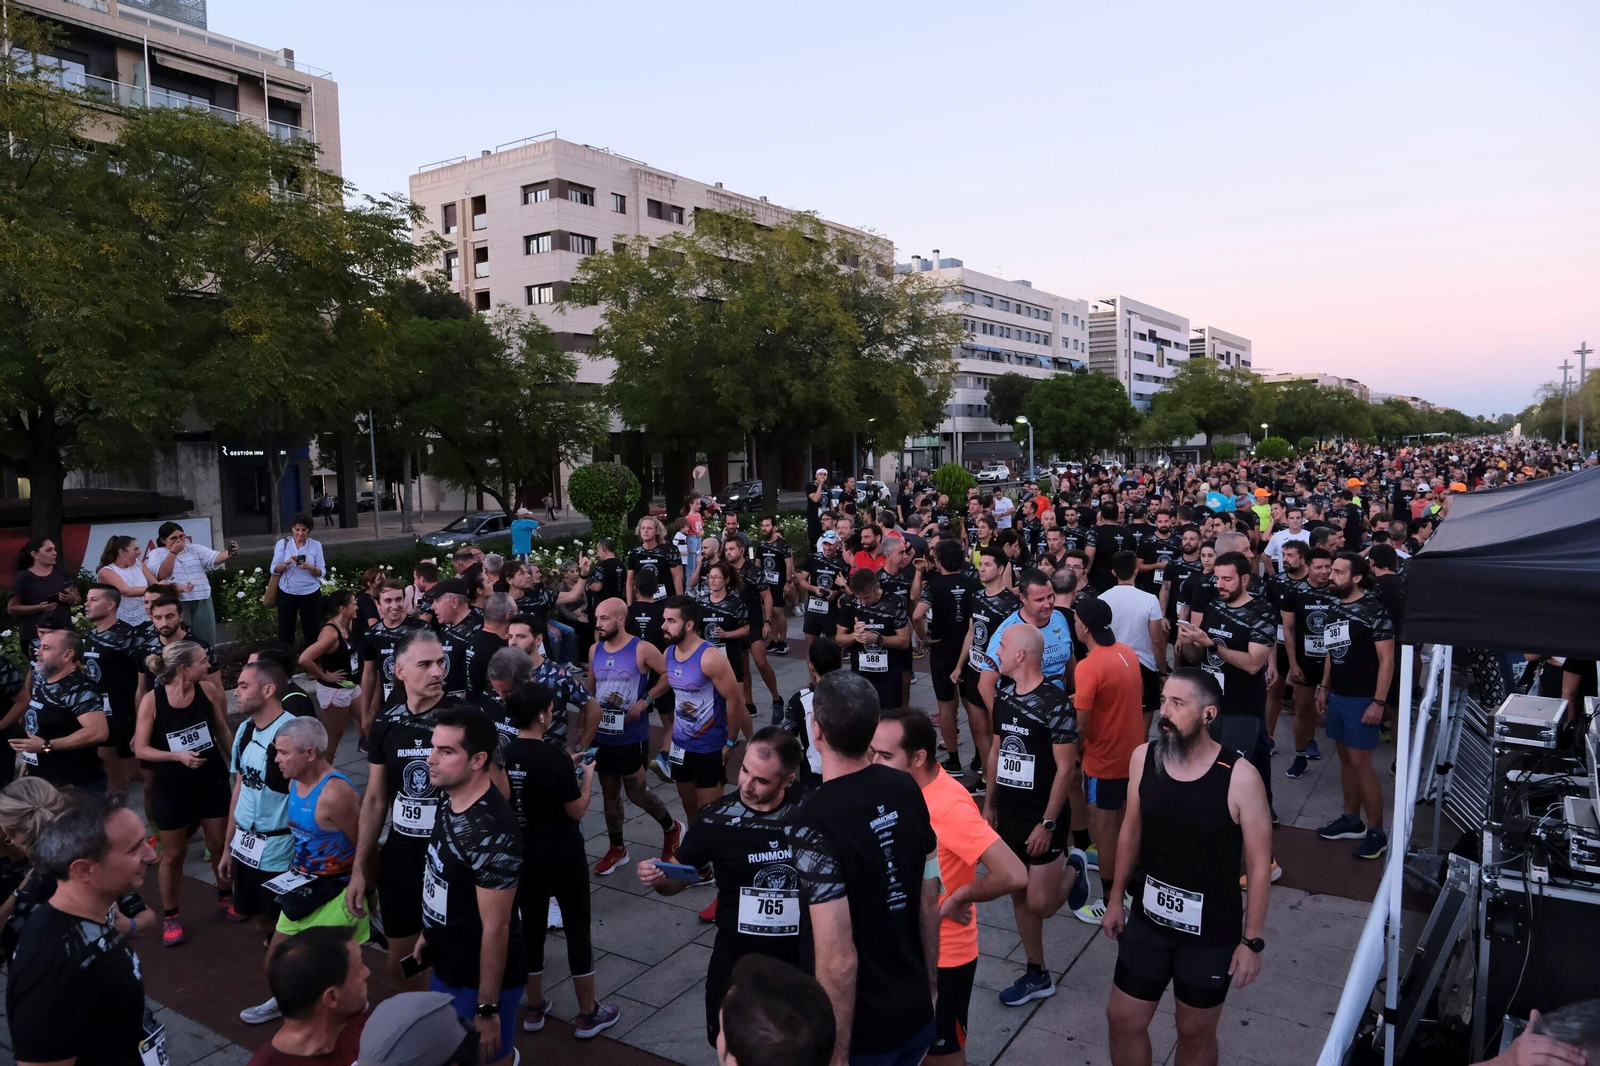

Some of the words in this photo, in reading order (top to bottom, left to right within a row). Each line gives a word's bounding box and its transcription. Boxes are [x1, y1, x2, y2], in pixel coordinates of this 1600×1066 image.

[866, 655, 880, 663] 588
[1001, 723, 1030, 736] RUNMONES
[180, 731, 200, 746] 389
[1003, 758, 1022, 773] 300
[401, 804, 422, 820] 759
[239, 833, 256, 850] 330
[747, 848, 793, 864] RUNMON
[757, 898, 784, 915] 765
[1156, 891, 1184, 913] 653
